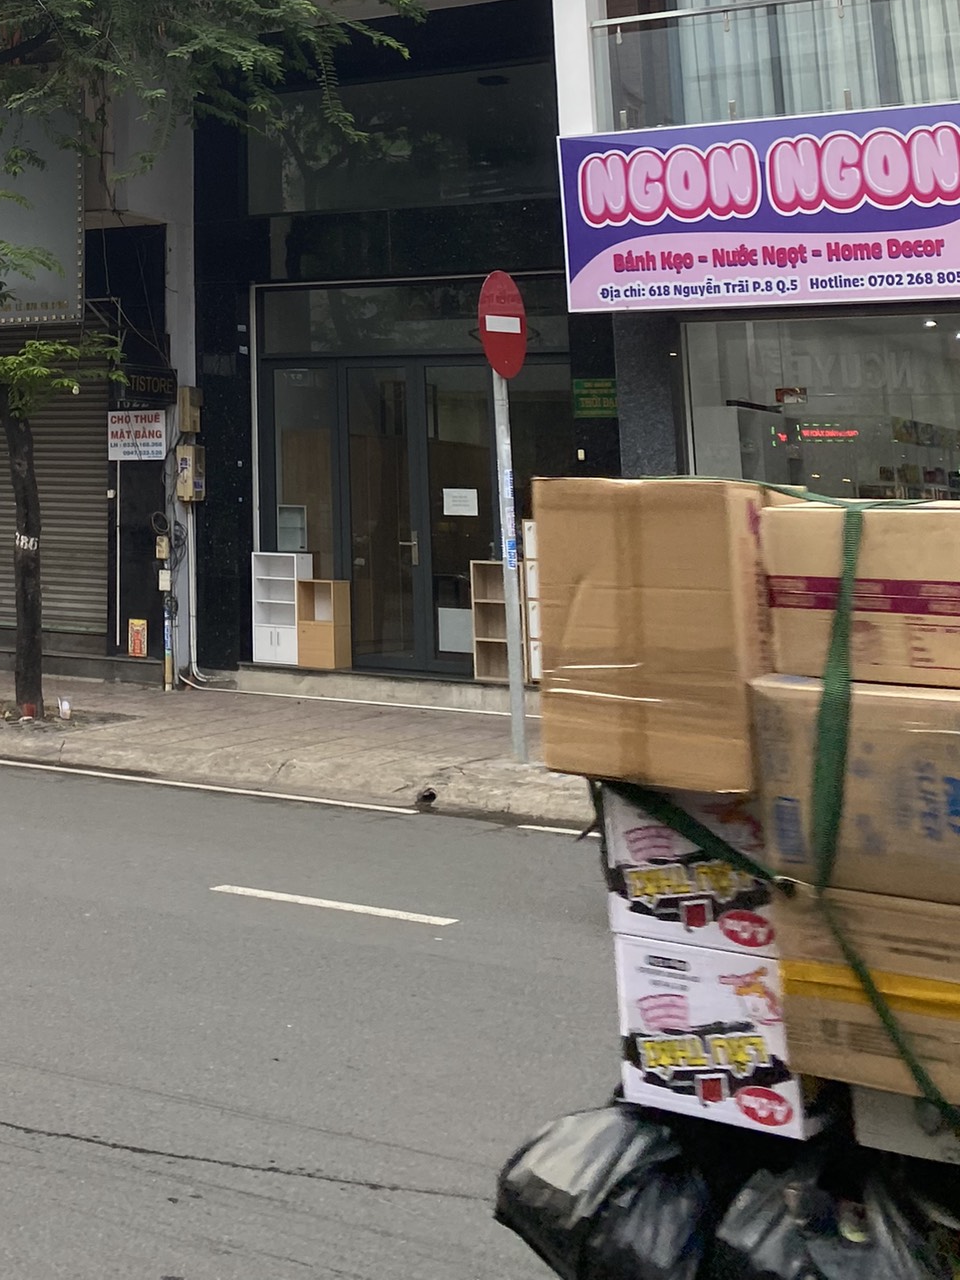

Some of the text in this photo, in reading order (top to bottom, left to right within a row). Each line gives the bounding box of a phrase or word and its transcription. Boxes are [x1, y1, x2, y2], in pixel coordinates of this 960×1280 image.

[581, 124, 960, 226] NGON NGON
[613, 249, 656, 272] Bánh
[661, 251, 694, 274] Kẹo
[712, 244, 758, 268] Nước
[761, 243, 807, 268] Ngọt
[826, 239, 882, 262] Home
[887, 237, 945, 259] Decor
[600, 277, 798, 302] Địa chỉ: 618 Nguyễn Trãi P.8 Q.5
[809, 271, 960, 291] Hotline: 0702 268 805
[110, 412, 160, 424] CHO THUÊ
[110, 426, 162, 442] MẶT BẰNG
